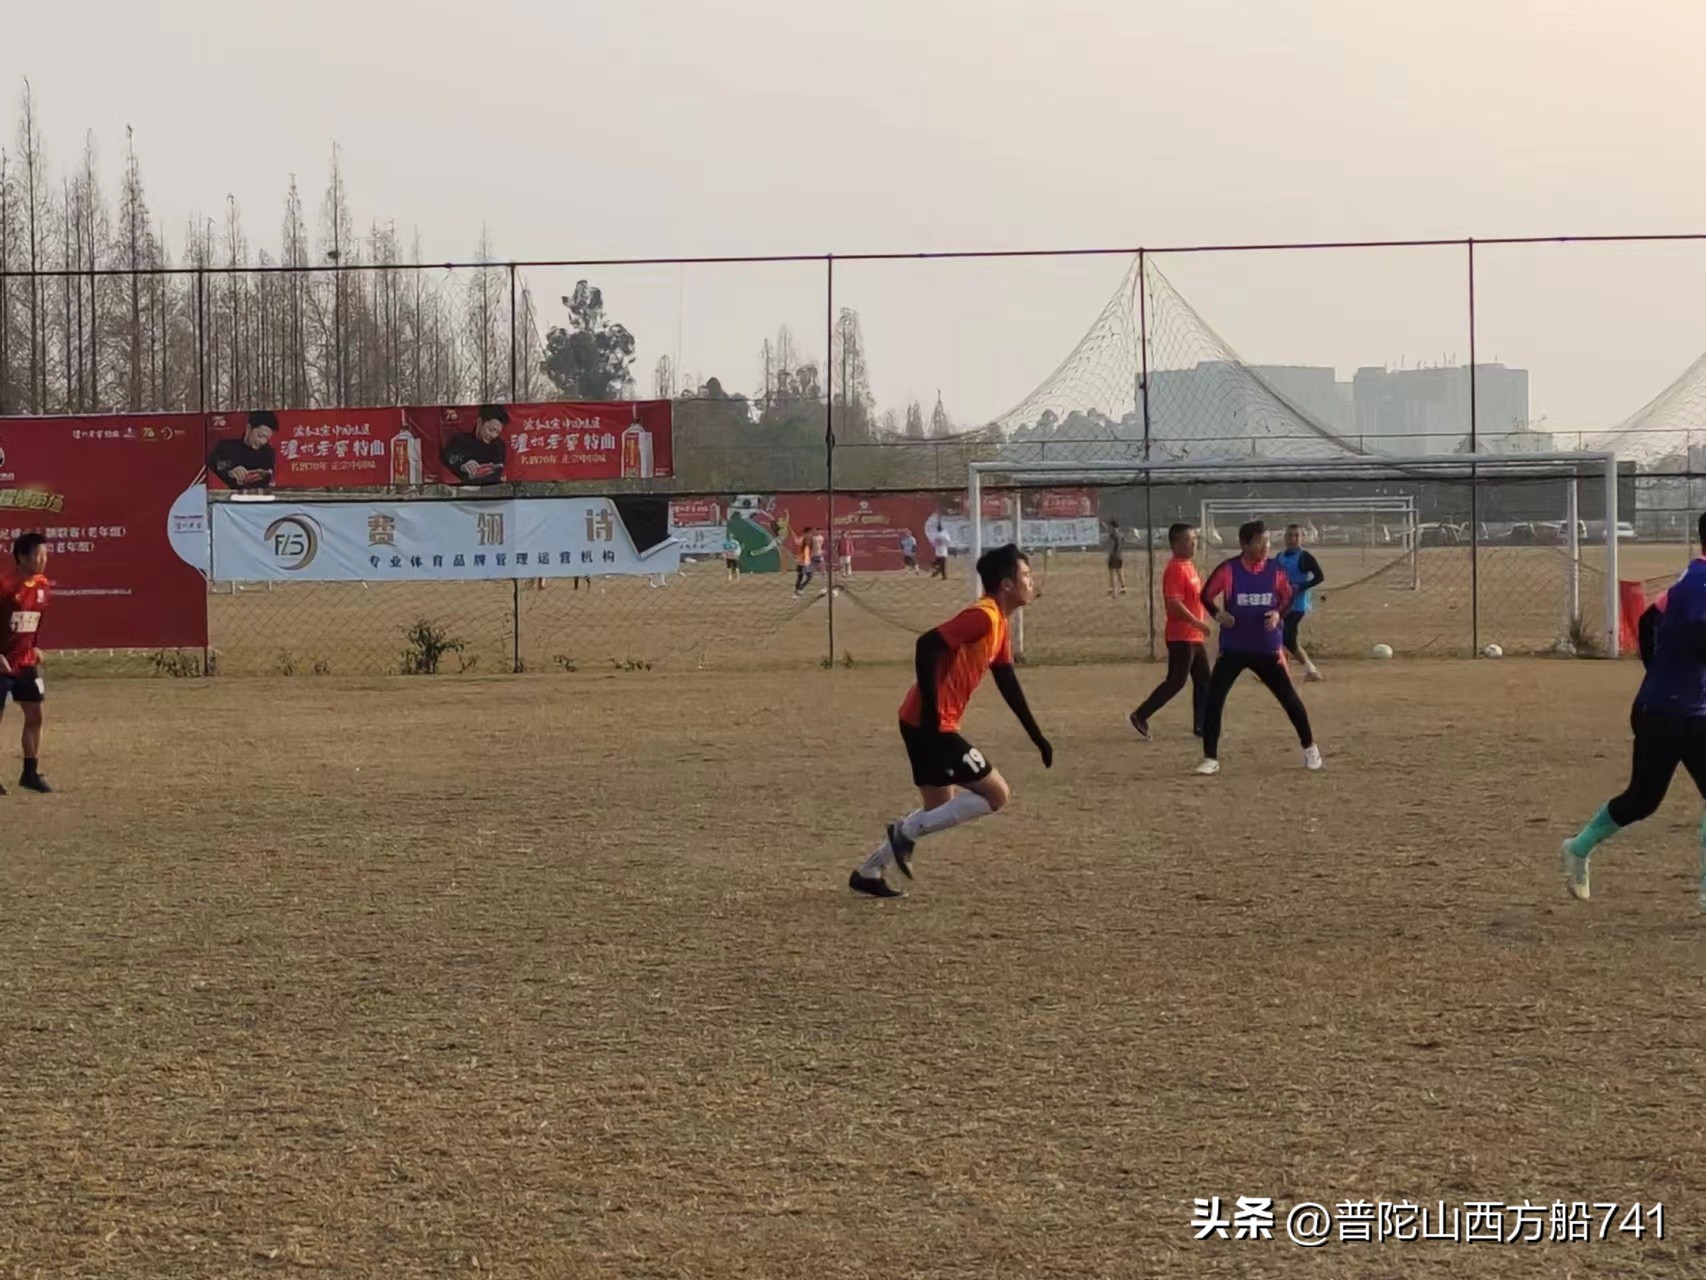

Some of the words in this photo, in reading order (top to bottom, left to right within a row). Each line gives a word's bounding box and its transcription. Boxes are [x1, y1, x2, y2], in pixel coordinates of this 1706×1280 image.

[370, 549, 615, 568] 专业体育品牌管理运营机构
[962, 747, 986, 773] 19
